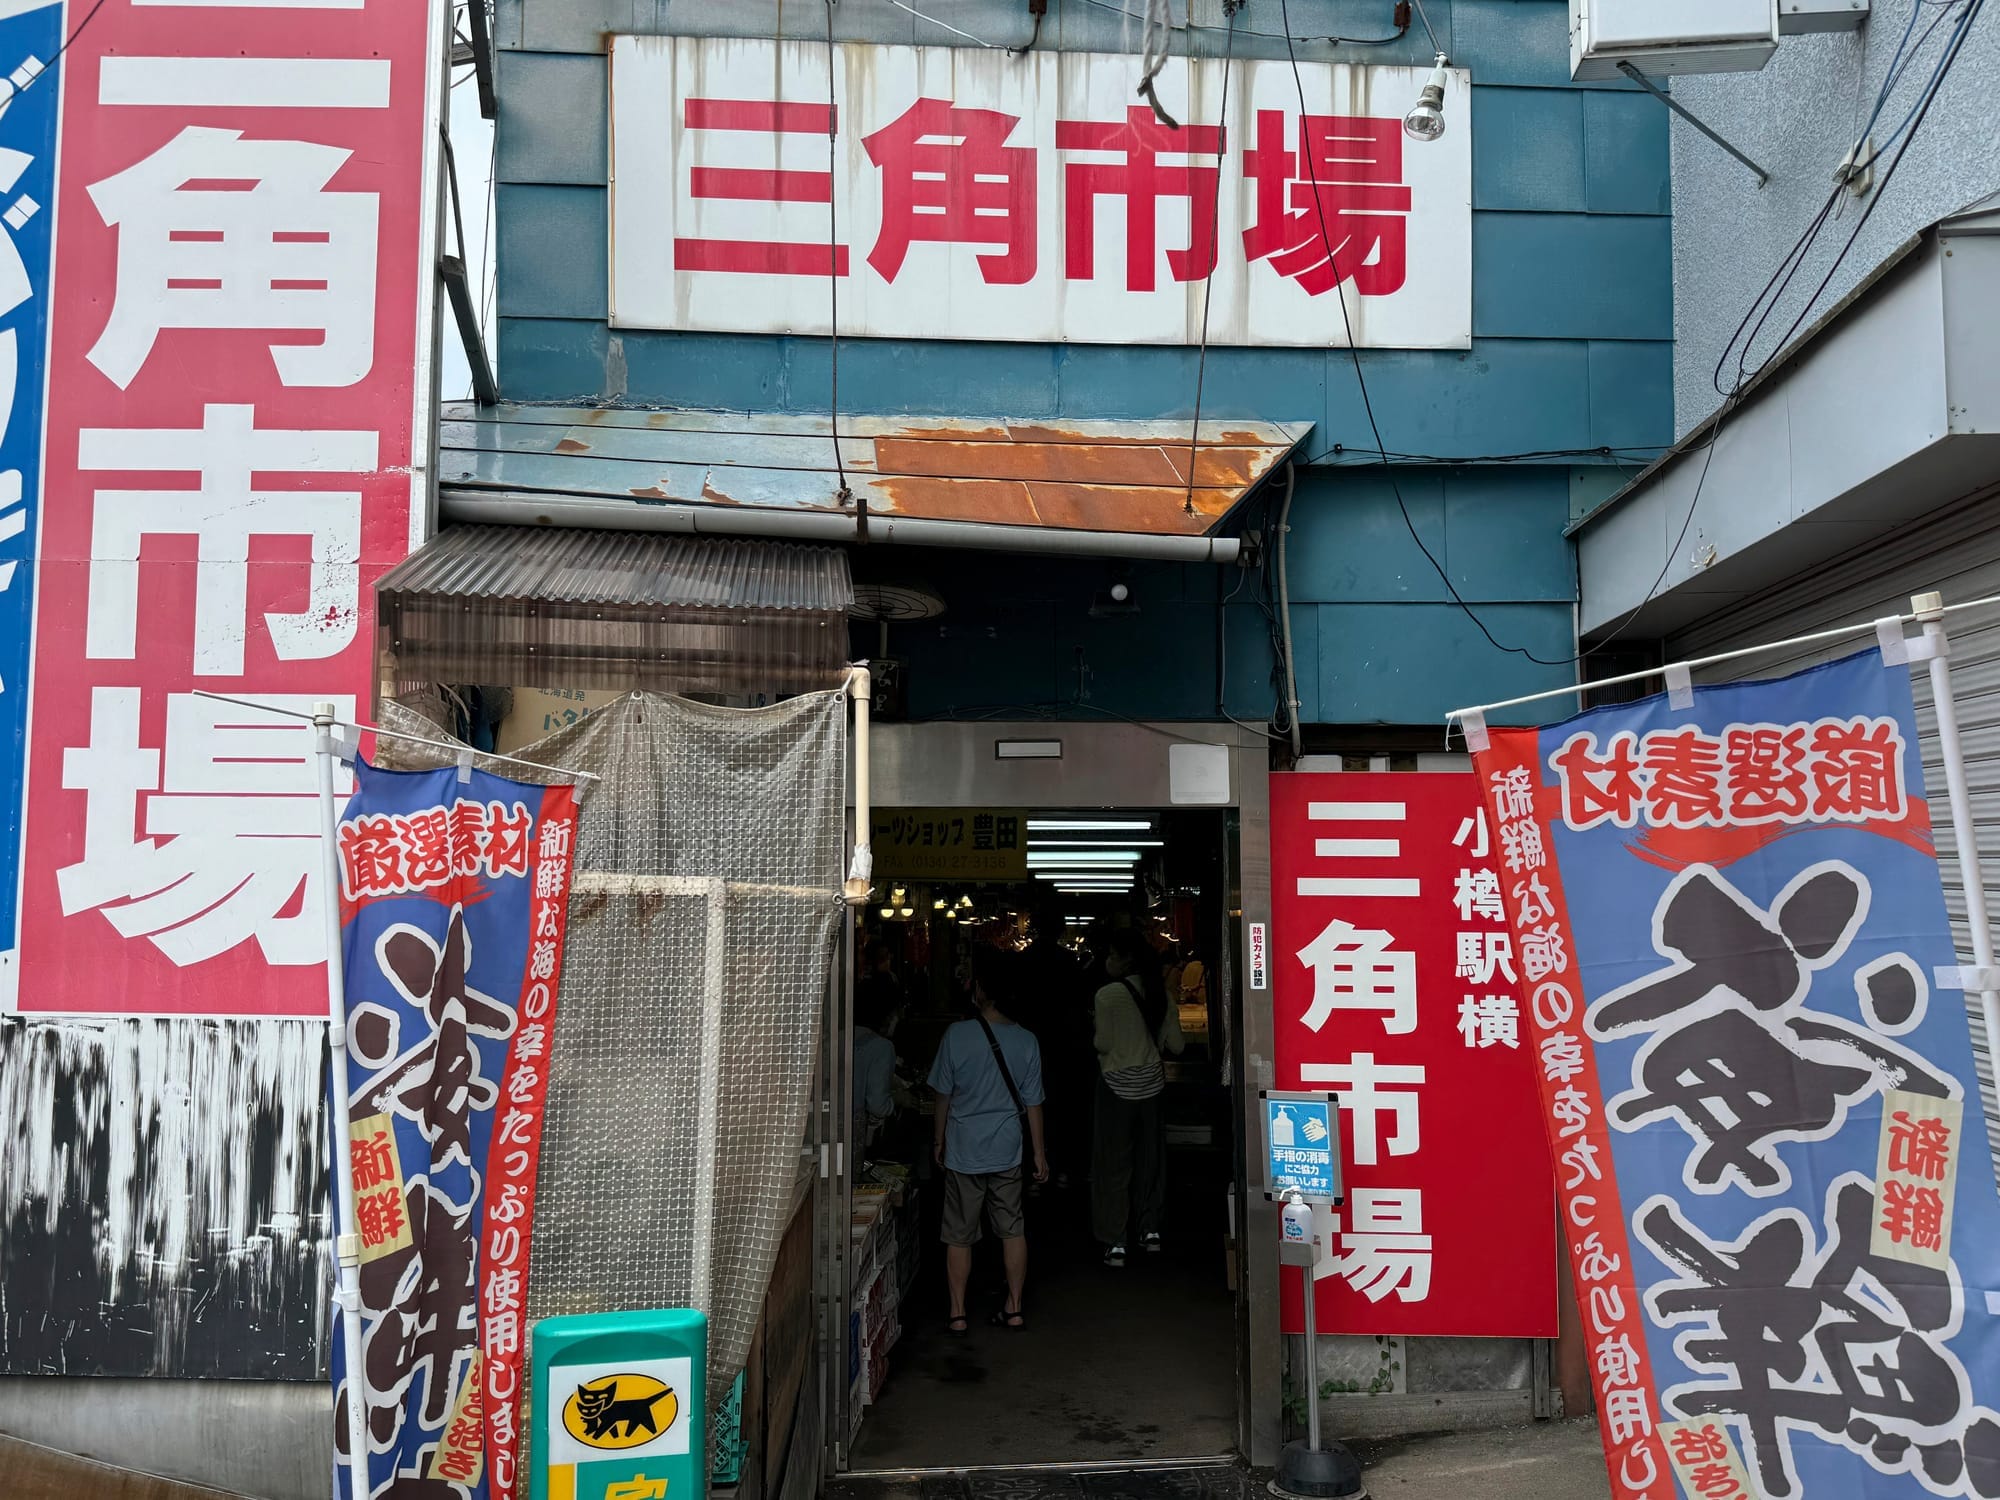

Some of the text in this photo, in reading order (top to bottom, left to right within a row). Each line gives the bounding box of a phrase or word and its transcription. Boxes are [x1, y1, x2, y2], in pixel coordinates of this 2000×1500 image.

[674, 97, 1411, 297] 三角市場
[337, 801, 532, 899] 厳選素材
[973, 813, 1018, 850] 豊田
[1252, 926, 1263, 987] 防犯カメラ設置
[1452, 806, 1520, 1049] 小樽駅横
[1296, 801, 1432, 1303] 三角市場
[351, 1131, 405, 1249] 新鮮
[484, 818, 572, 1500] 新鮮な海の幸をたっぷり使用しまし
[1273, 1149, 1330, 1165] 手指の消毒
[1277, 1175, 1328, 1188] お願いします
[1284, 1164, 1319, 1176] にご協力
